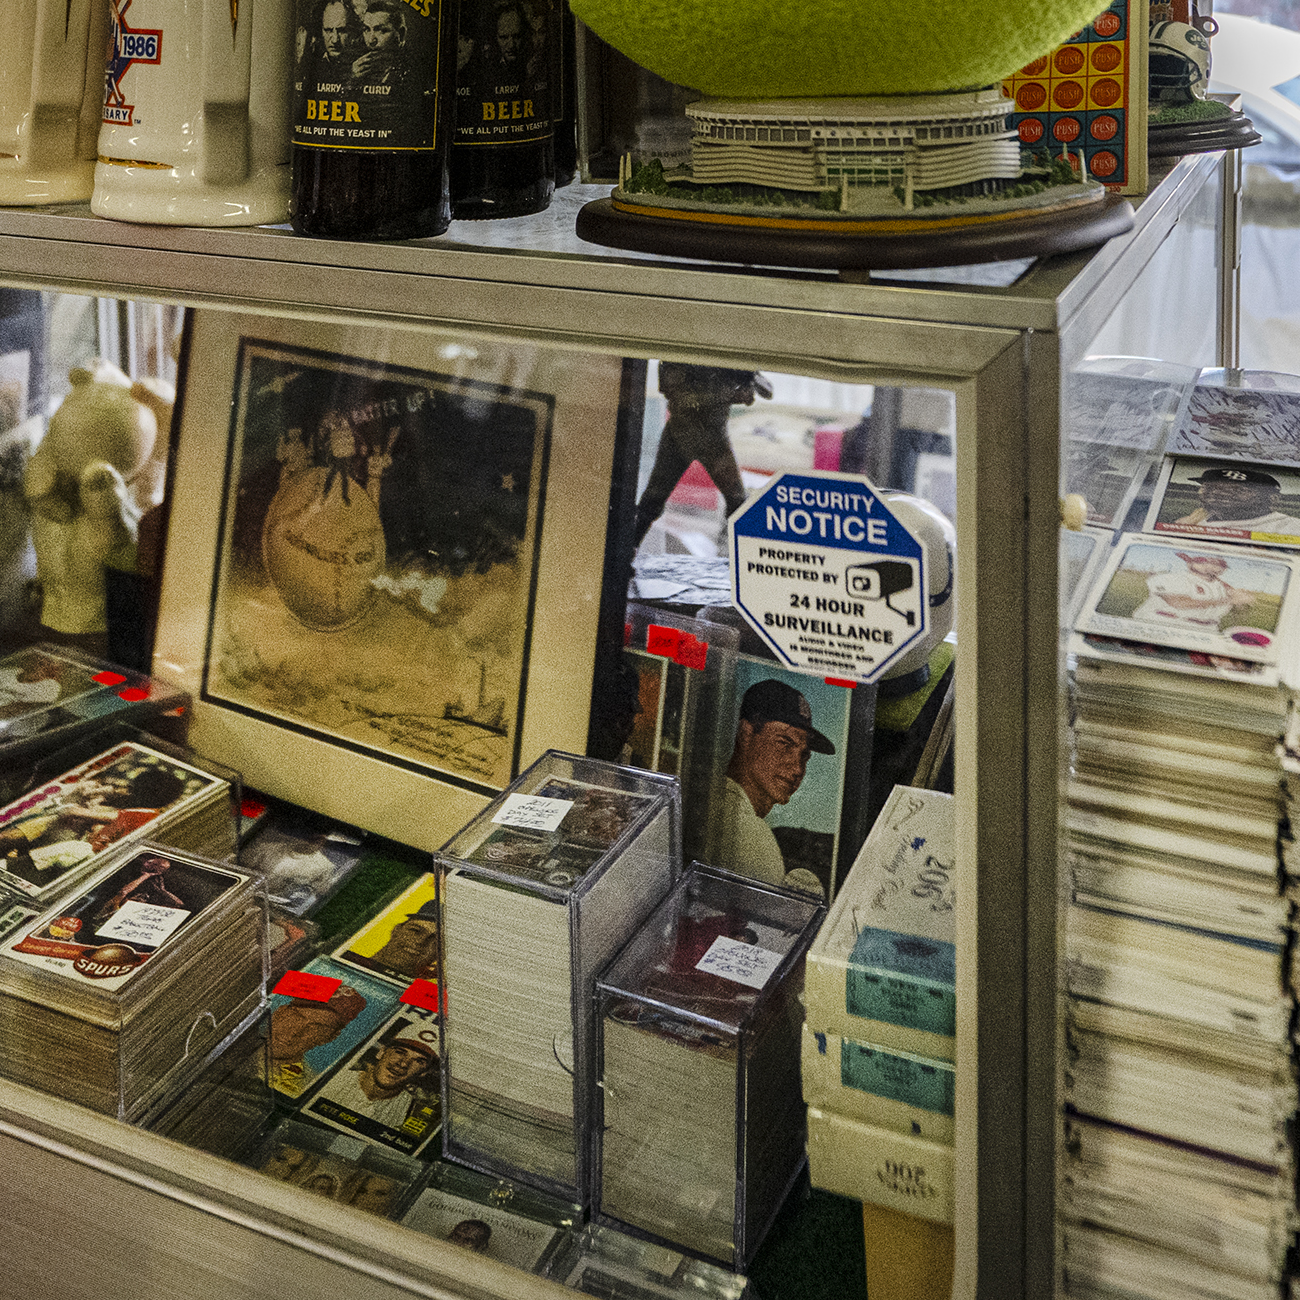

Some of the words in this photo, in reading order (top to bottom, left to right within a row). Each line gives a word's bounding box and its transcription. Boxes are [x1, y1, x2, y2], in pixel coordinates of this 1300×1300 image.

[1096, 17, 1119, 30] PUSH
[123, 36, 156, 57] 1986
[1058, 54, 1081, 67] PUSH
[1095, 52, 1118, 65] PUSH
[317, 83, 342, 93] LARRY
[364, 85, 392, 95] CURLY
[495, 85, 519, 94] LARRY
[1021, 90, 1043, 102] PUSH
[1058, 88, 1080, 100] PUSH
[1095, 86, 1117, 99] PUSH
[307, 99, 362, 123] BEER
[482, 99, 535, 121] BEER
[314, 127, 328, 135] PUT
[329, 128, 345, 137] THE
[347, 129, 376, 138] YEAST
[476, 125, 491, 134] ALL
[493, 124, 508, 133] PUT
[510, 123, 524, 132] THE
[1019, 125, 1041, 137] PUSH
[1056, 124, 1079, 136] PUSH
[1093, 122, 1117, 135] PUSH
[1093, 158, 1117, 170] PUSH
[776, 485, 875, 514] SECURITY
[766, 506, 888, 546] NOTICE
[759, 547, 826, 566] PROPERTY
[747, 561, 819, 582] PROTECTED
[823, 573, 839, 585] BY
[790, 593, 810, 609] 24
[815, 596, 865, 618] HOUR
[764, 612, 893, 645] SURVEILLANCE
[800, 645, 853, 661] MONITORED
[807, 656, 856, 671] RECORDED
[76, 959, 134, 978] SPURS
[319, 1102, 339, 1116] PETE
[338, 1111, 359, 1125] ROSE
